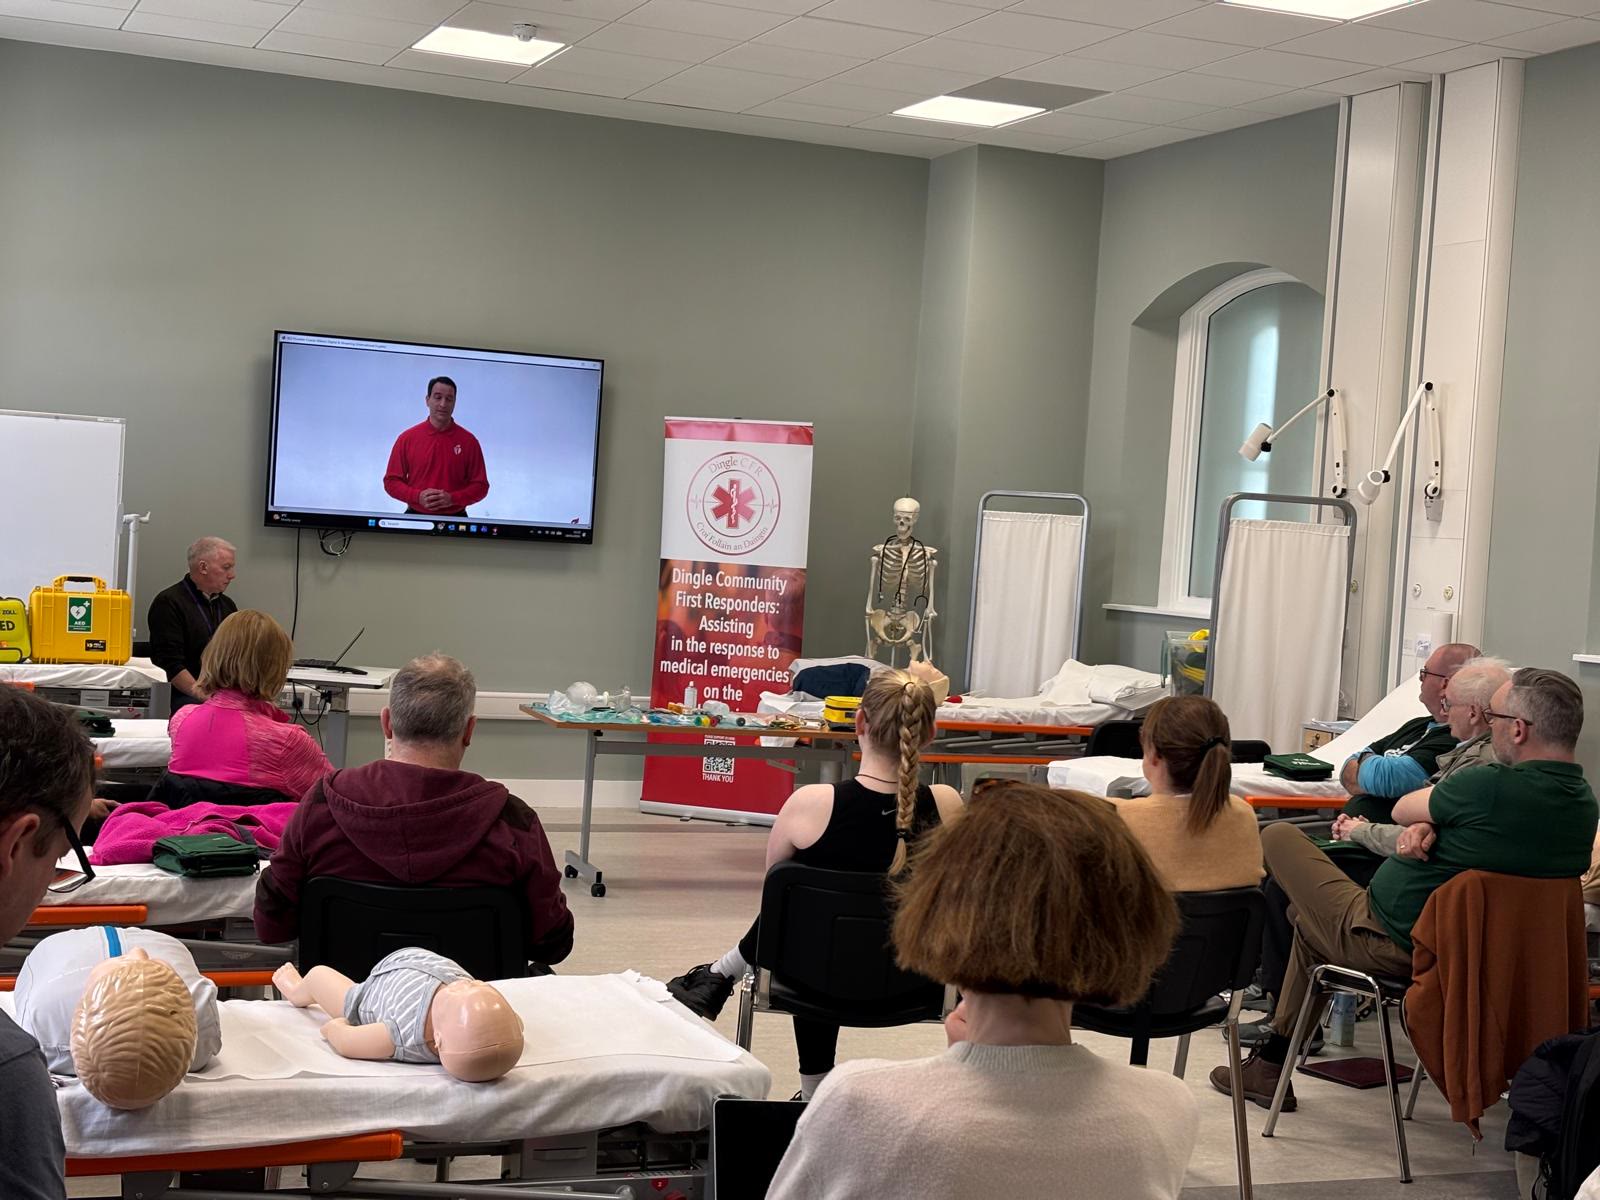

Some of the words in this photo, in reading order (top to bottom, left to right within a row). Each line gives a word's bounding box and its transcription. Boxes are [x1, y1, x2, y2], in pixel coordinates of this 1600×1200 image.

[708, 456, 738, 473] Dingle
[733, 543, 743, 551] an
[672, 567, 713, 588] Dingle
[716, 571, 787, 595] Community
[676, 591, 702, 608] First
[705, 594, 780, 615] Responders:
[699, 616, 754, 638] Assisting
[671, 636, 683, 651] in
[686, 637, 706, 653] the
[710, 642, 764, 659] response
[767, 646, 780, 660] to
[660, 658, 708, 676] medical
[711, 664, 790, 685] emergencies
[703, 685, 719, 699] on
[722, 684, 743, 702] the
[702, 773, 721, 782] THANK
[721, 775, 734, 783] YOU
